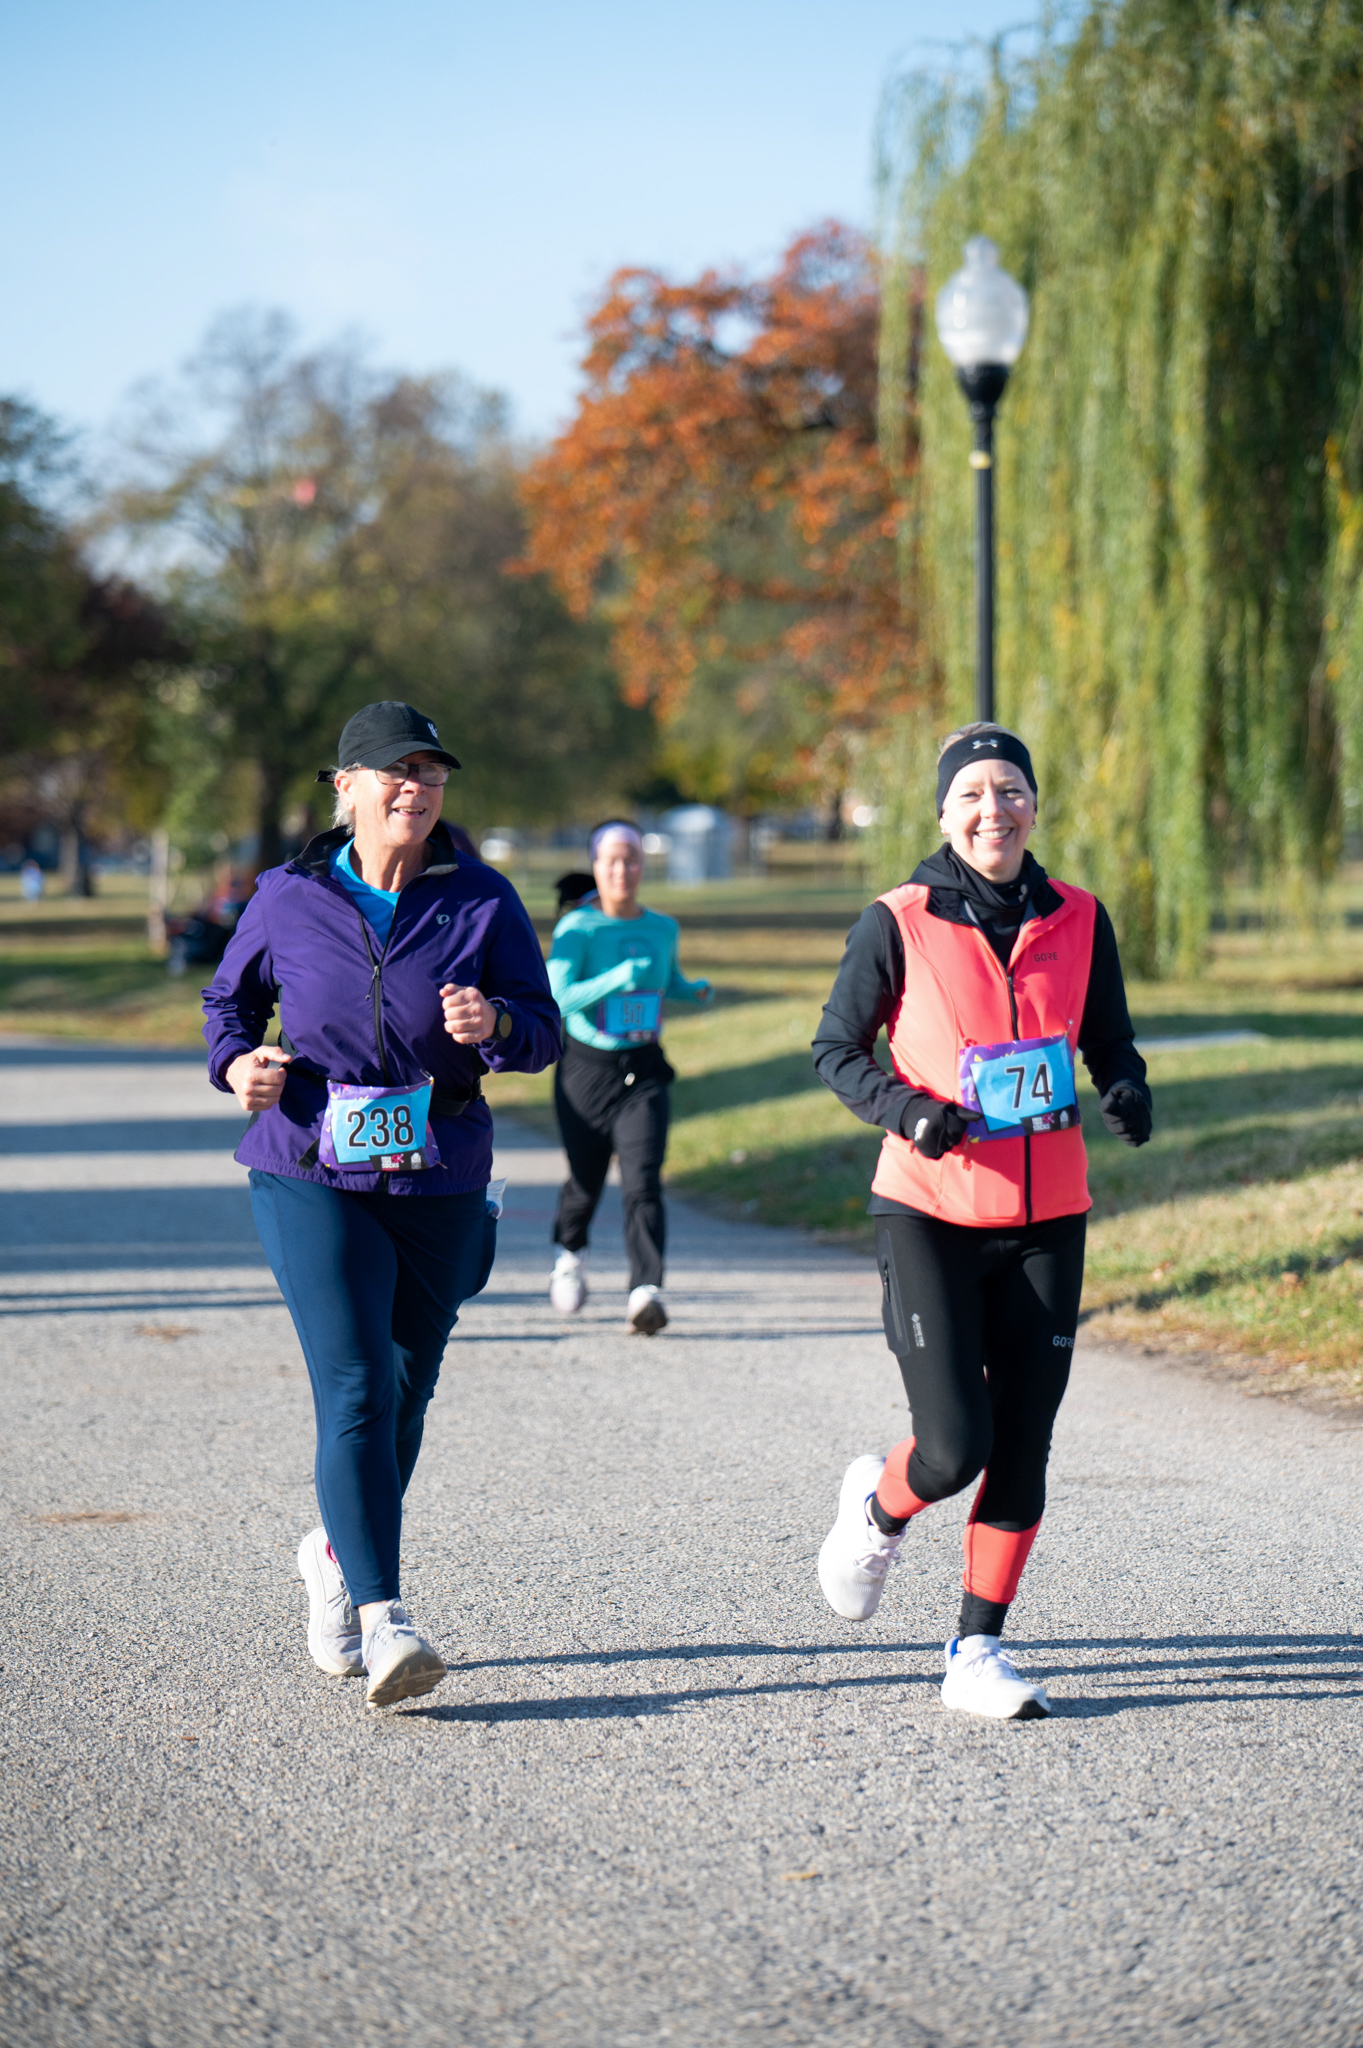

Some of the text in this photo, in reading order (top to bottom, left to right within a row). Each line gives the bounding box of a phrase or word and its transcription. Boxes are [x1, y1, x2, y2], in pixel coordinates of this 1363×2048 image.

[1034, 952, 1059, 962] GORE
[1004, 1062, 1053, 1110] 74
[346, 1104, 415, 1148] 238
